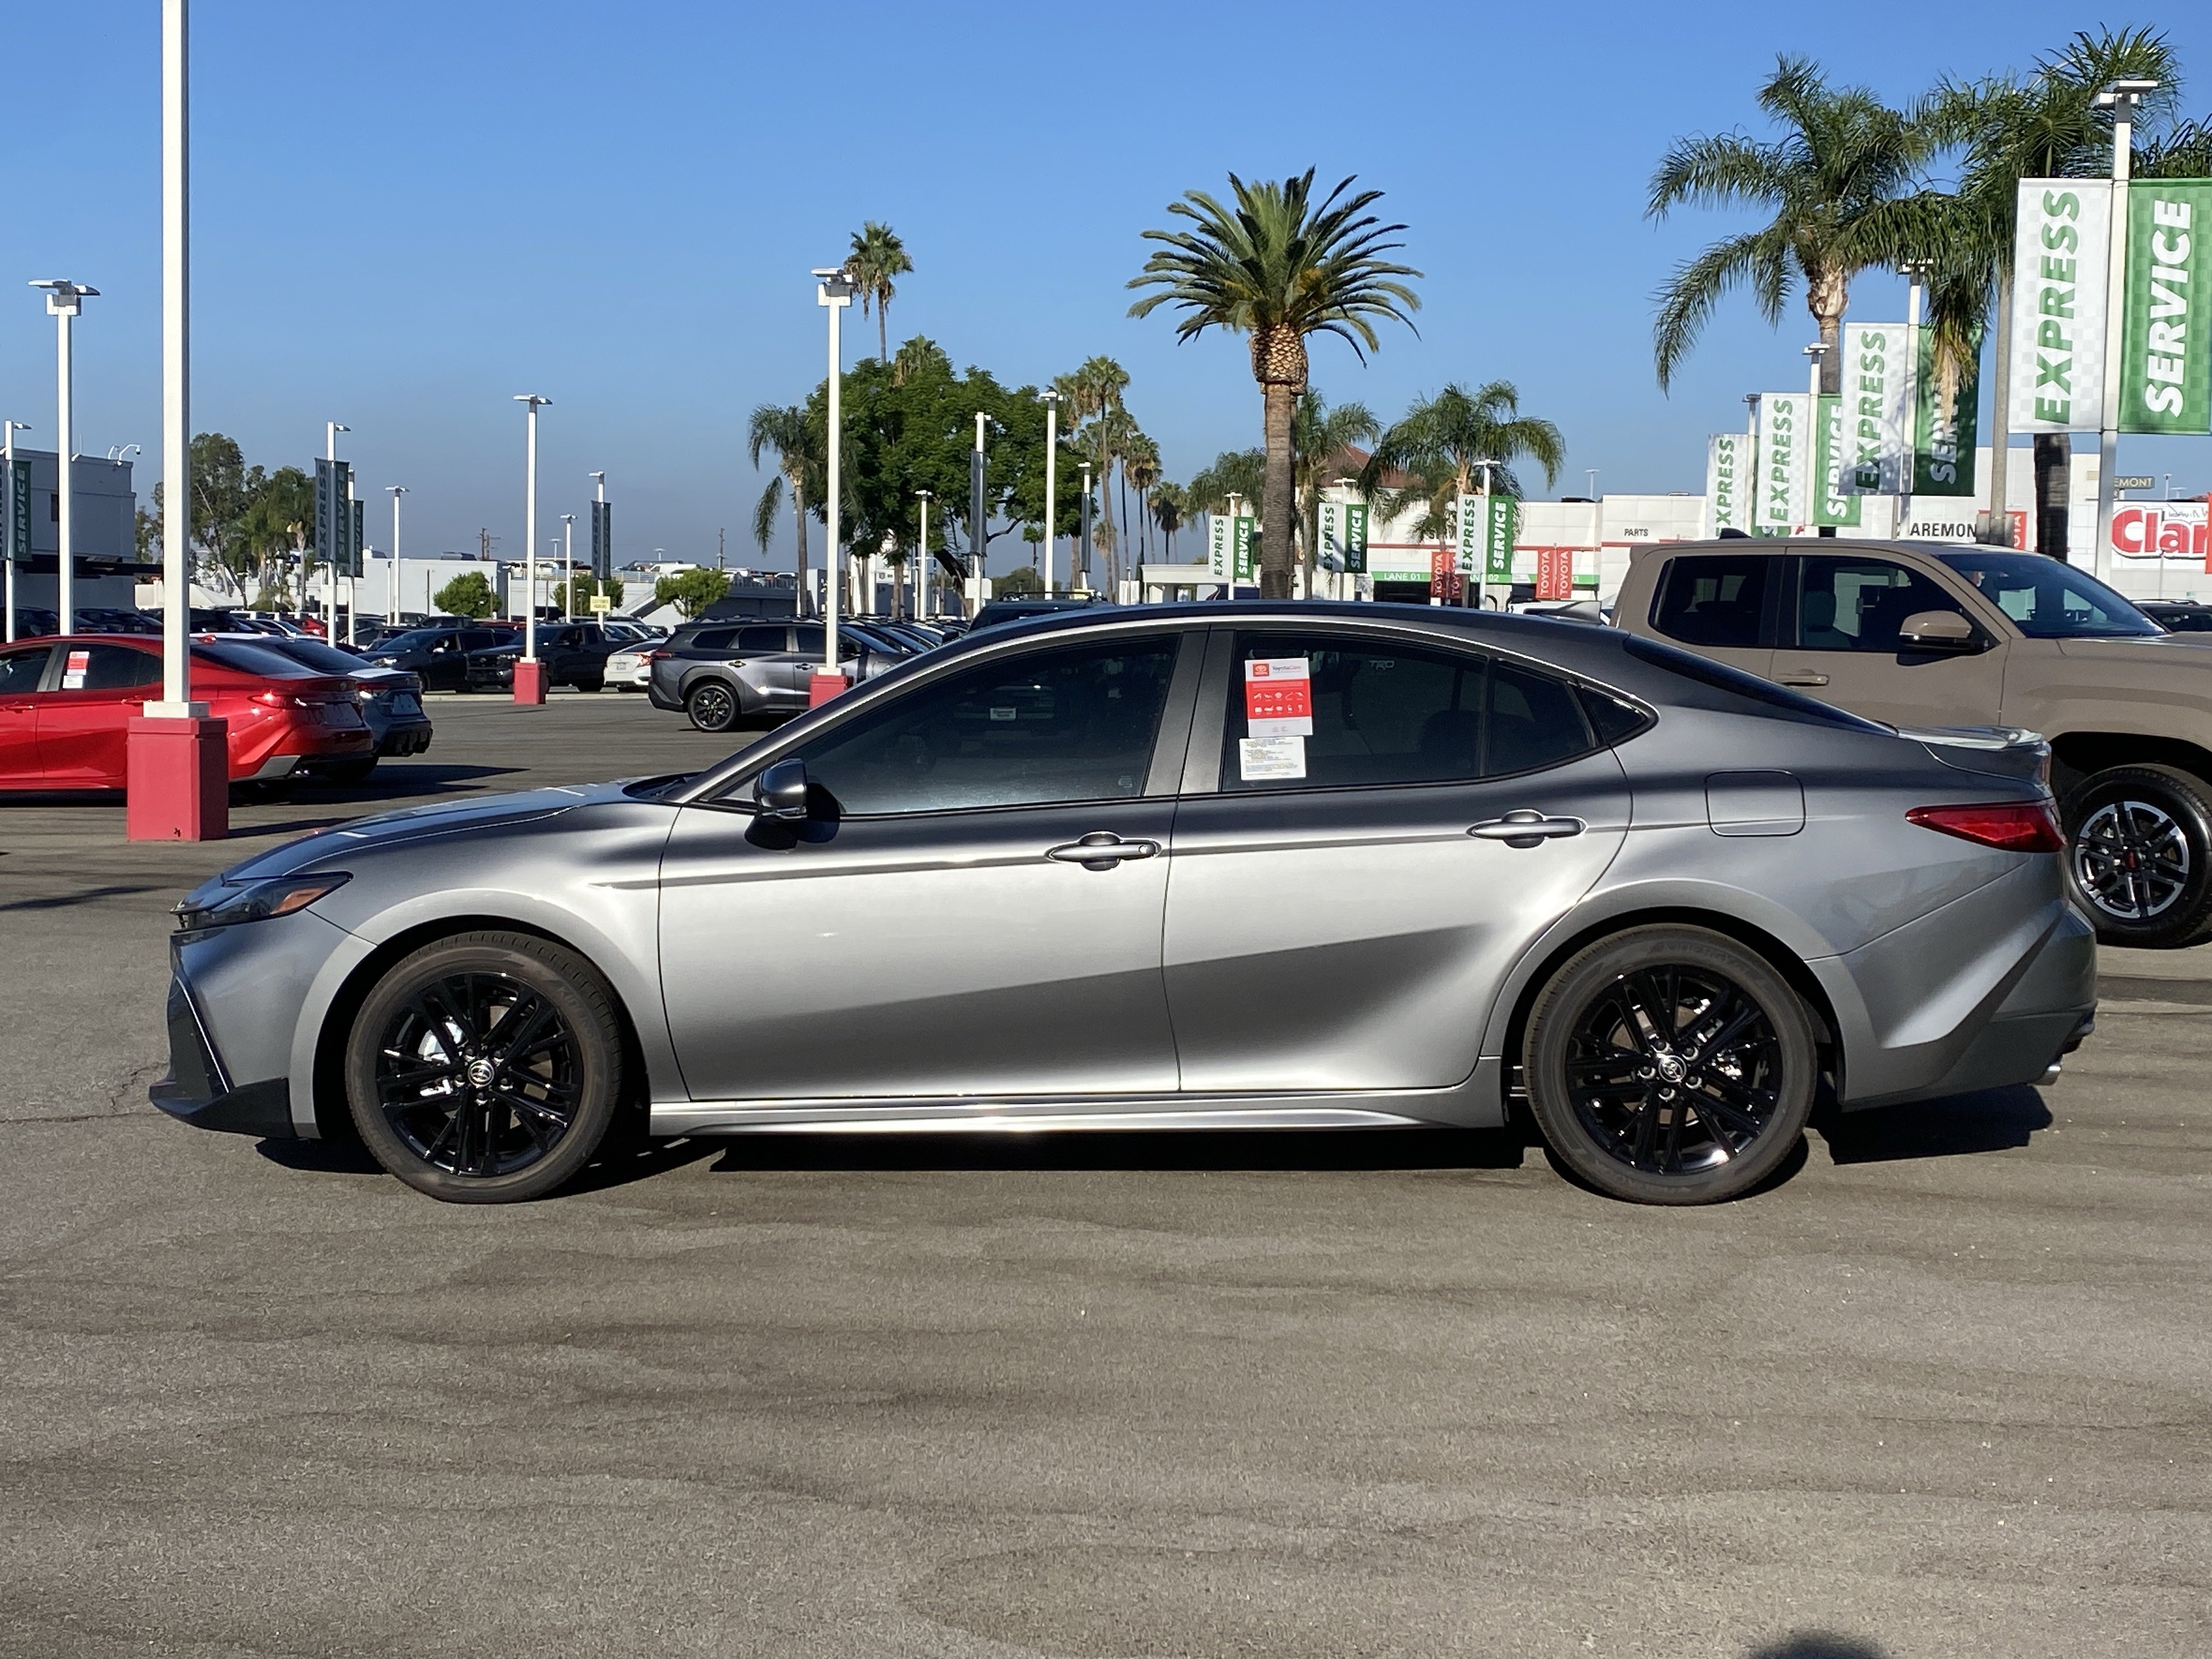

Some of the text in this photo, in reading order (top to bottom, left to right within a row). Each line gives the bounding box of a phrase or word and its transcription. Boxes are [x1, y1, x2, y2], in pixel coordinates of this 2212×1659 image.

[2034, 189, 2080, 425] EXPRESS
[2145, 199, 2191, 418] SERVICE
[1855, 330, 1886, 489] EXPRESS
[1931, 382, 1960, 484] SERV
[1770, 399, 1793, 521] EXPRESS
[2115, 478, 2153, 487] EMONT
[16, 469, 27, 554] SERVICE
[319, 464, 327, 558] EXPRESS
[1323, 507, 1334, 570] EXPRESS
[1350, 509, 1363, 569] SERVICE
[1462, 498, 1475, 571] EXPRESS
[1493, 502, 1506, 569] SERVICE
[1624, 528, 1649, 537] PARTS
[1910, 523, 1976, 537] AREMON
[2112, 509, 2208, 554] Clar
[1214, 518, 1223, 576] EXPRESS
[1238, 521, 1249, 575] SERVICE
[1435, 554, 1443, 594] TOYOTA
[1540, 551, 1550, 595] TOYOTA
[1560, 551, 1569, 596] TOYOTA
